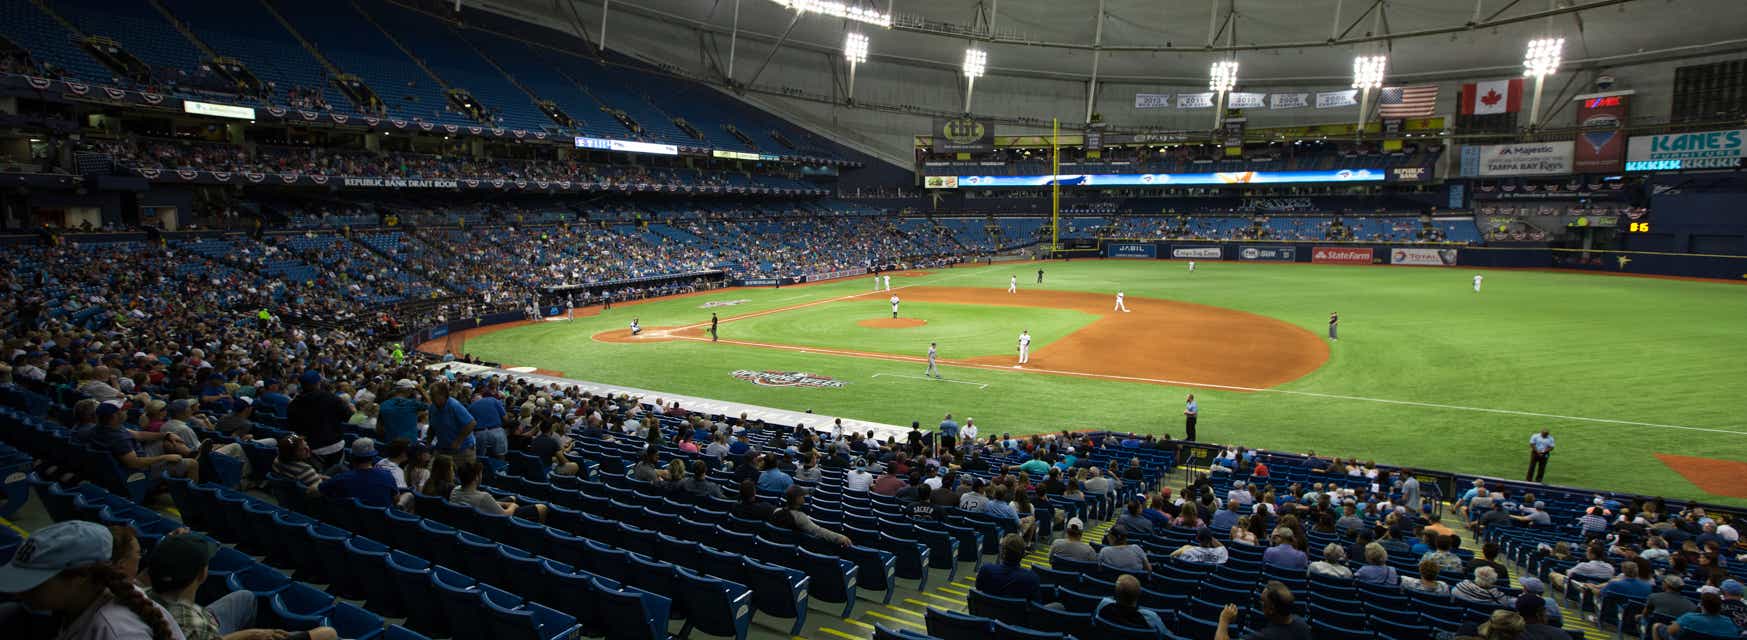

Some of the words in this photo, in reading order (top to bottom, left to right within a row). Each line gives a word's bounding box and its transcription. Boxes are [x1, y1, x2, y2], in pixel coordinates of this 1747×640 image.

[1651, 130, 1742, 152] KANE'S
[1514, 146, 1552, 155] Majestic
[1488, 163, 1518, 171] TAMPA
[1520, 162, 1537, 170] BAY
[1540, 161, 1563, 171] Rays
[344, 179, 384, 187] REPUBLIC
[408, 180, 433, 188] DRAFT
[434, 180, 458, 188] ROOM
[1119, 244, 1145, 252] JABIL
